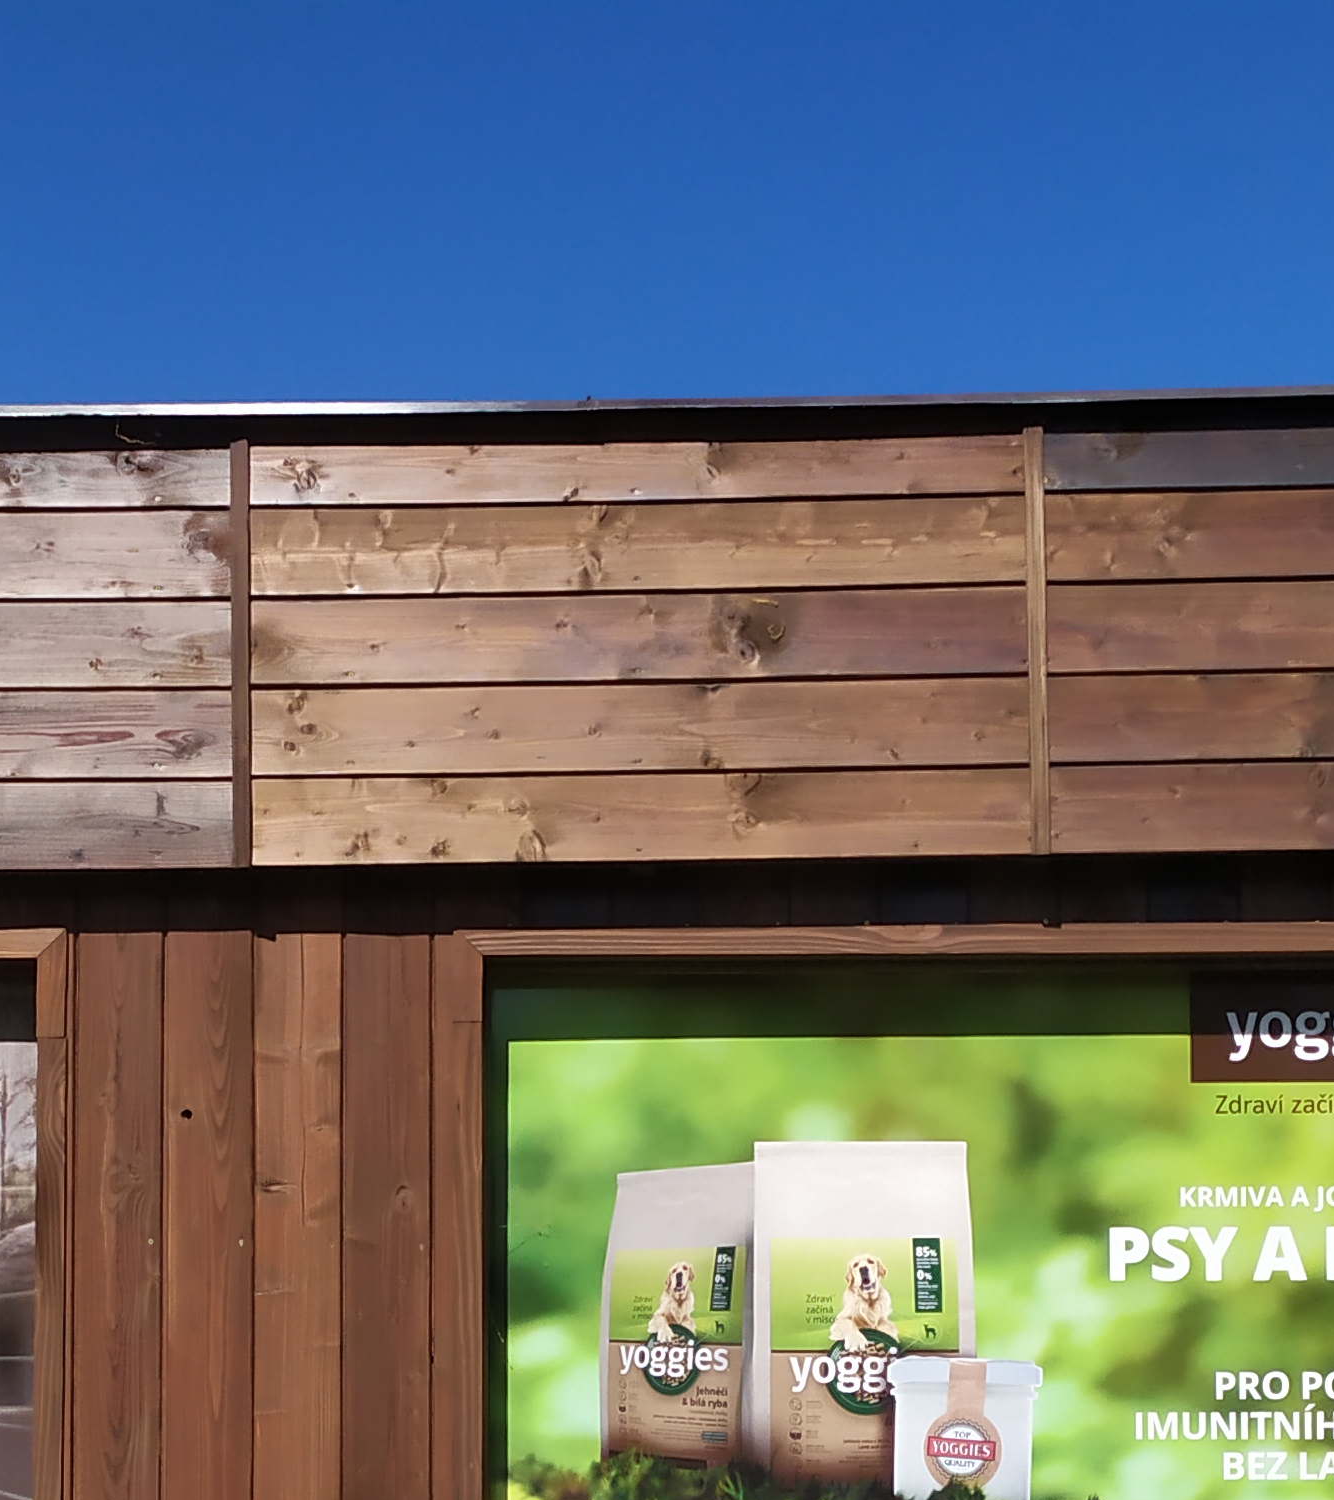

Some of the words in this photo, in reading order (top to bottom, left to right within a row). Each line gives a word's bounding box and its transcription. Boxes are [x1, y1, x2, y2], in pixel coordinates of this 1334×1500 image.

[1215, 1094, 1283, 1114] Zdraví
[1179, 1186, 1284, 1207] KRMIVA
[1291, 1186, 1310, 1207] A
[1108, 1226, 1238, 1281] PSY
[1253, 1226, 1307, 1281] A
[620, 1339, 728, 1378] yoggies
[1215, 1371, 1289, 1400] PRO
[933, 1440, 991, 1457] YOGGIES
[944, 1459, 976, 1467] QUALITY
[1222, 1452, 1288, 1481] BEZ
